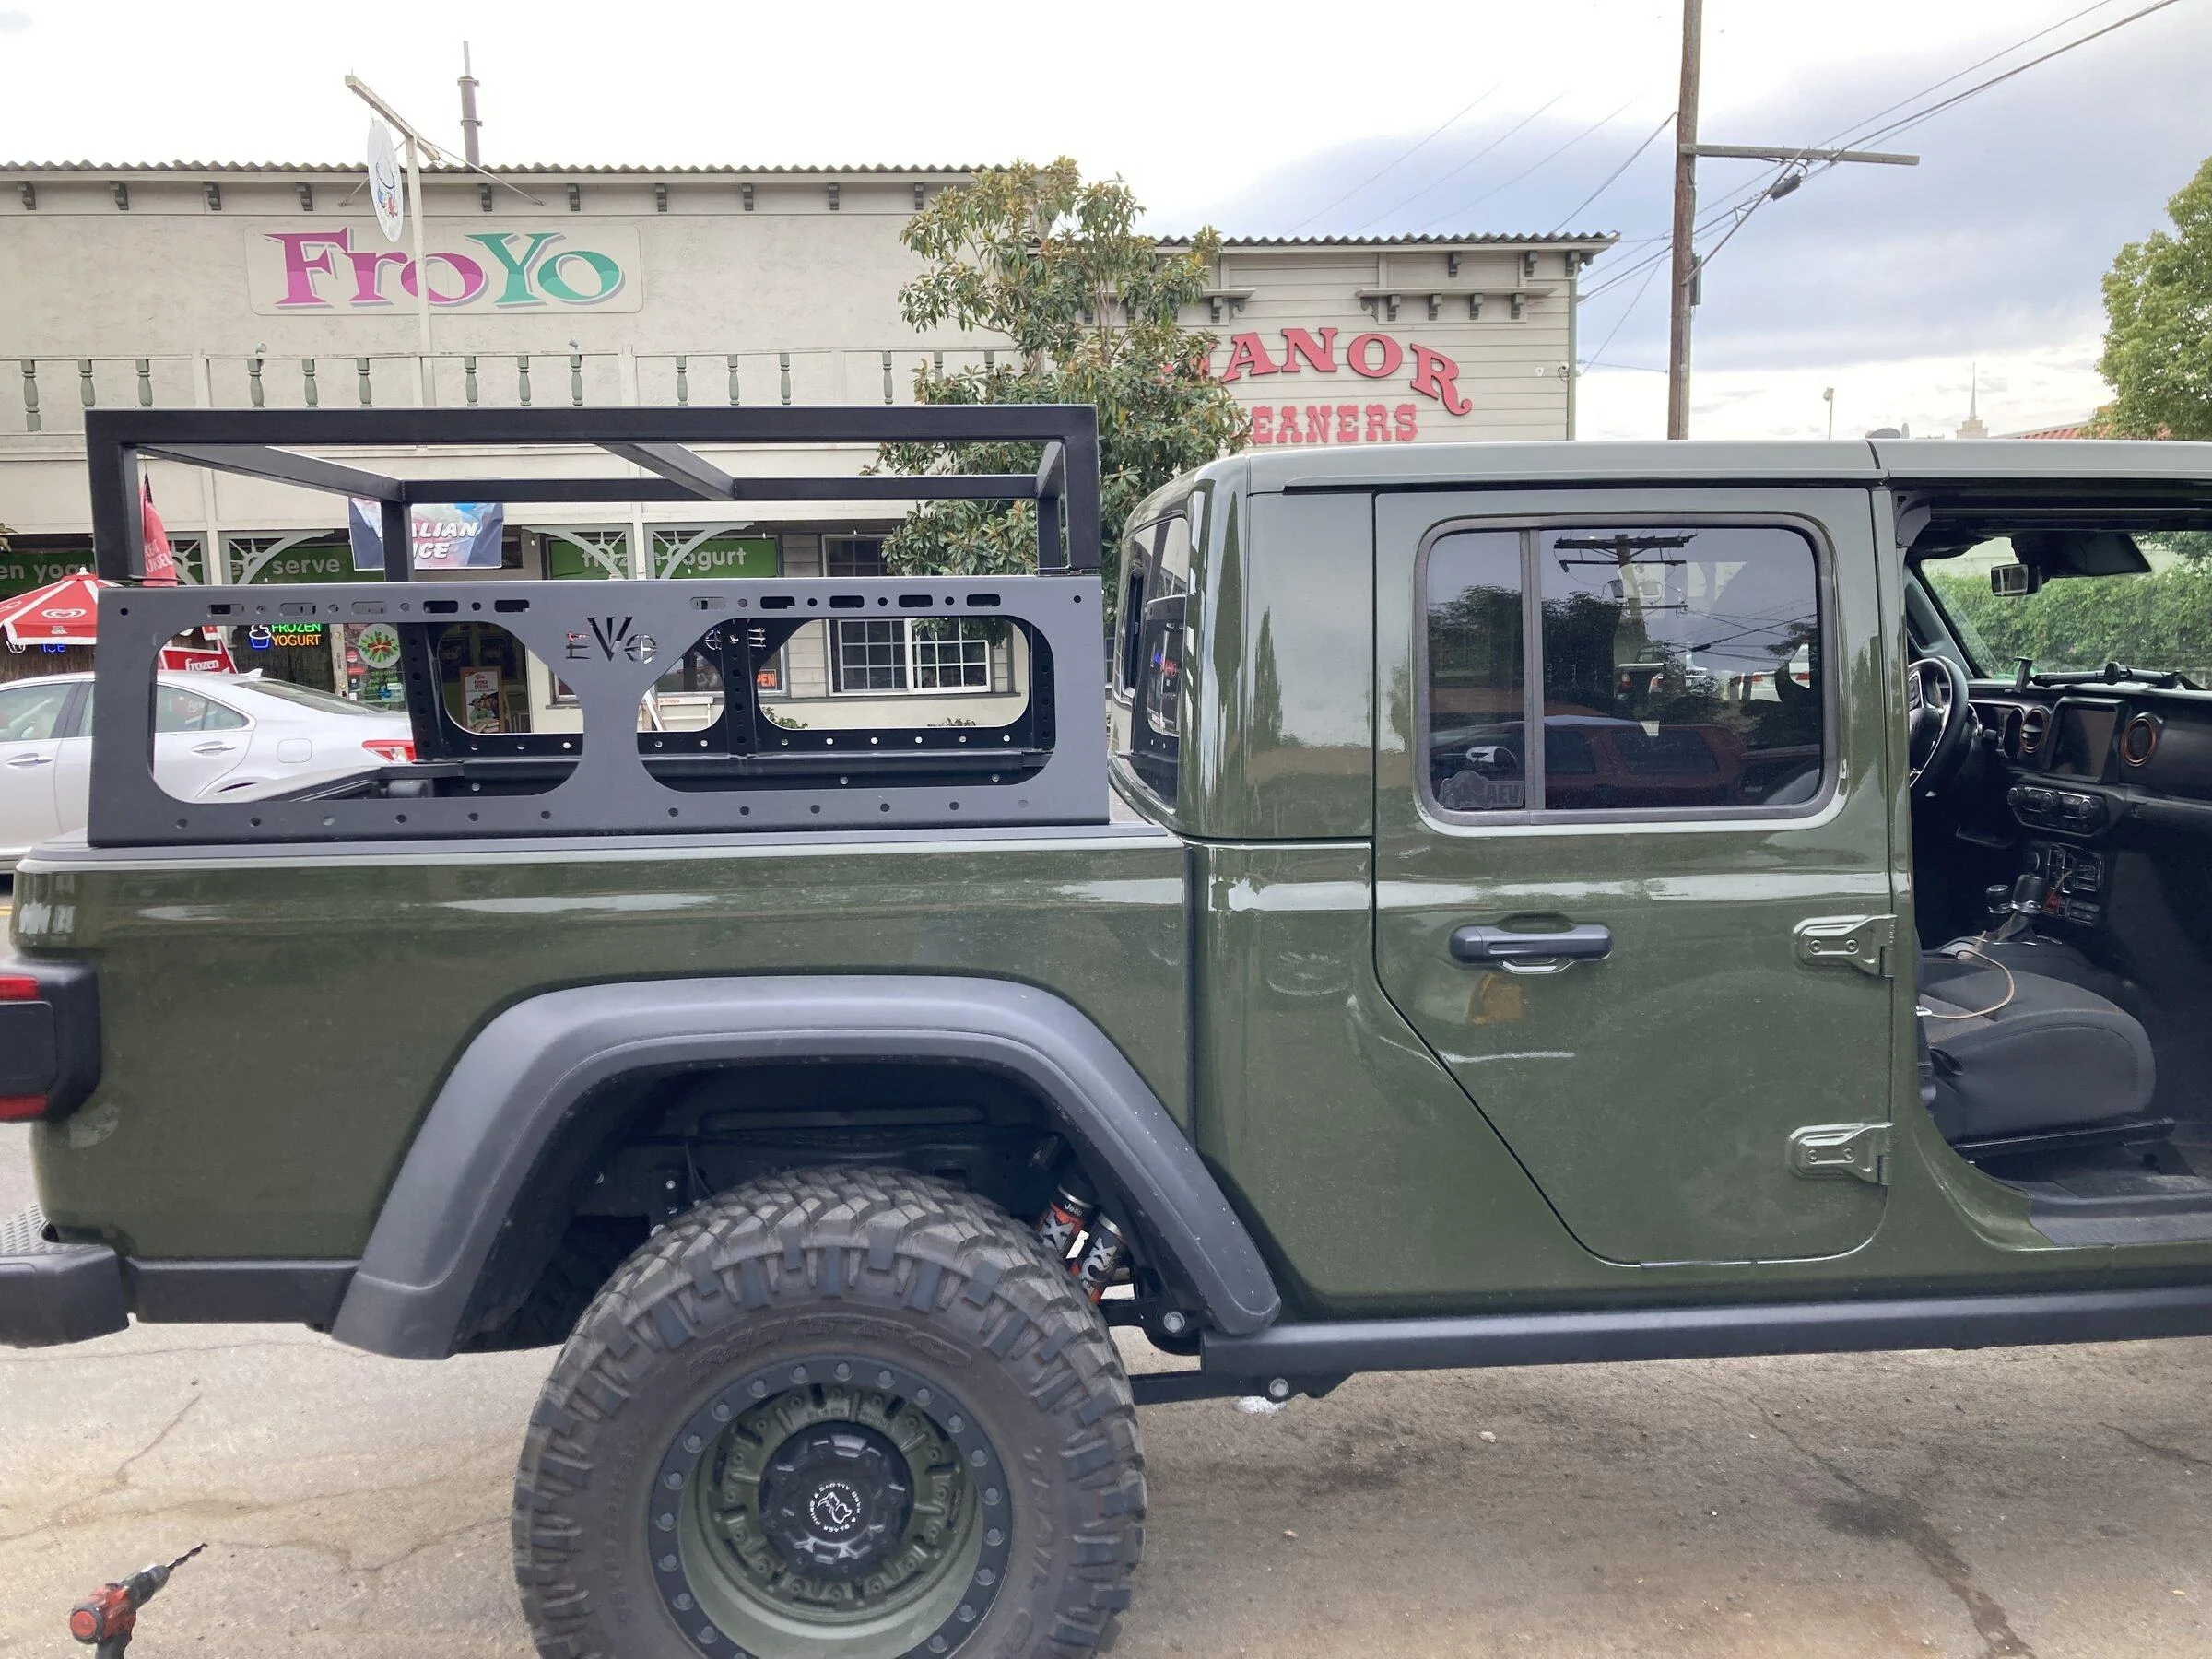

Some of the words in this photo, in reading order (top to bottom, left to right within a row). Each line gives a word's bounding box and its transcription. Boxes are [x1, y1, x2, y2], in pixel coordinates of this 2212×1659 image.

[263, 227, 625, 308] FroYo
[1193, 327, 1472, 416] ANOR
[1250, 404, 1418, 444] EANERS
[412, 522, 479, 538] LIAN
[272, 559, 340, 575] serve
[683, 547, 747, 571] ogurt
[271, 623, 322, 633] FROZEN
[271, 634, 322, 646] YOGURT
[566, 617, 657, 664] EVO
[185, 658, 219, 671] frozen
[756, 673, 776, 687] PEN
[1065, 1203, 1083, 1217] Jeep
